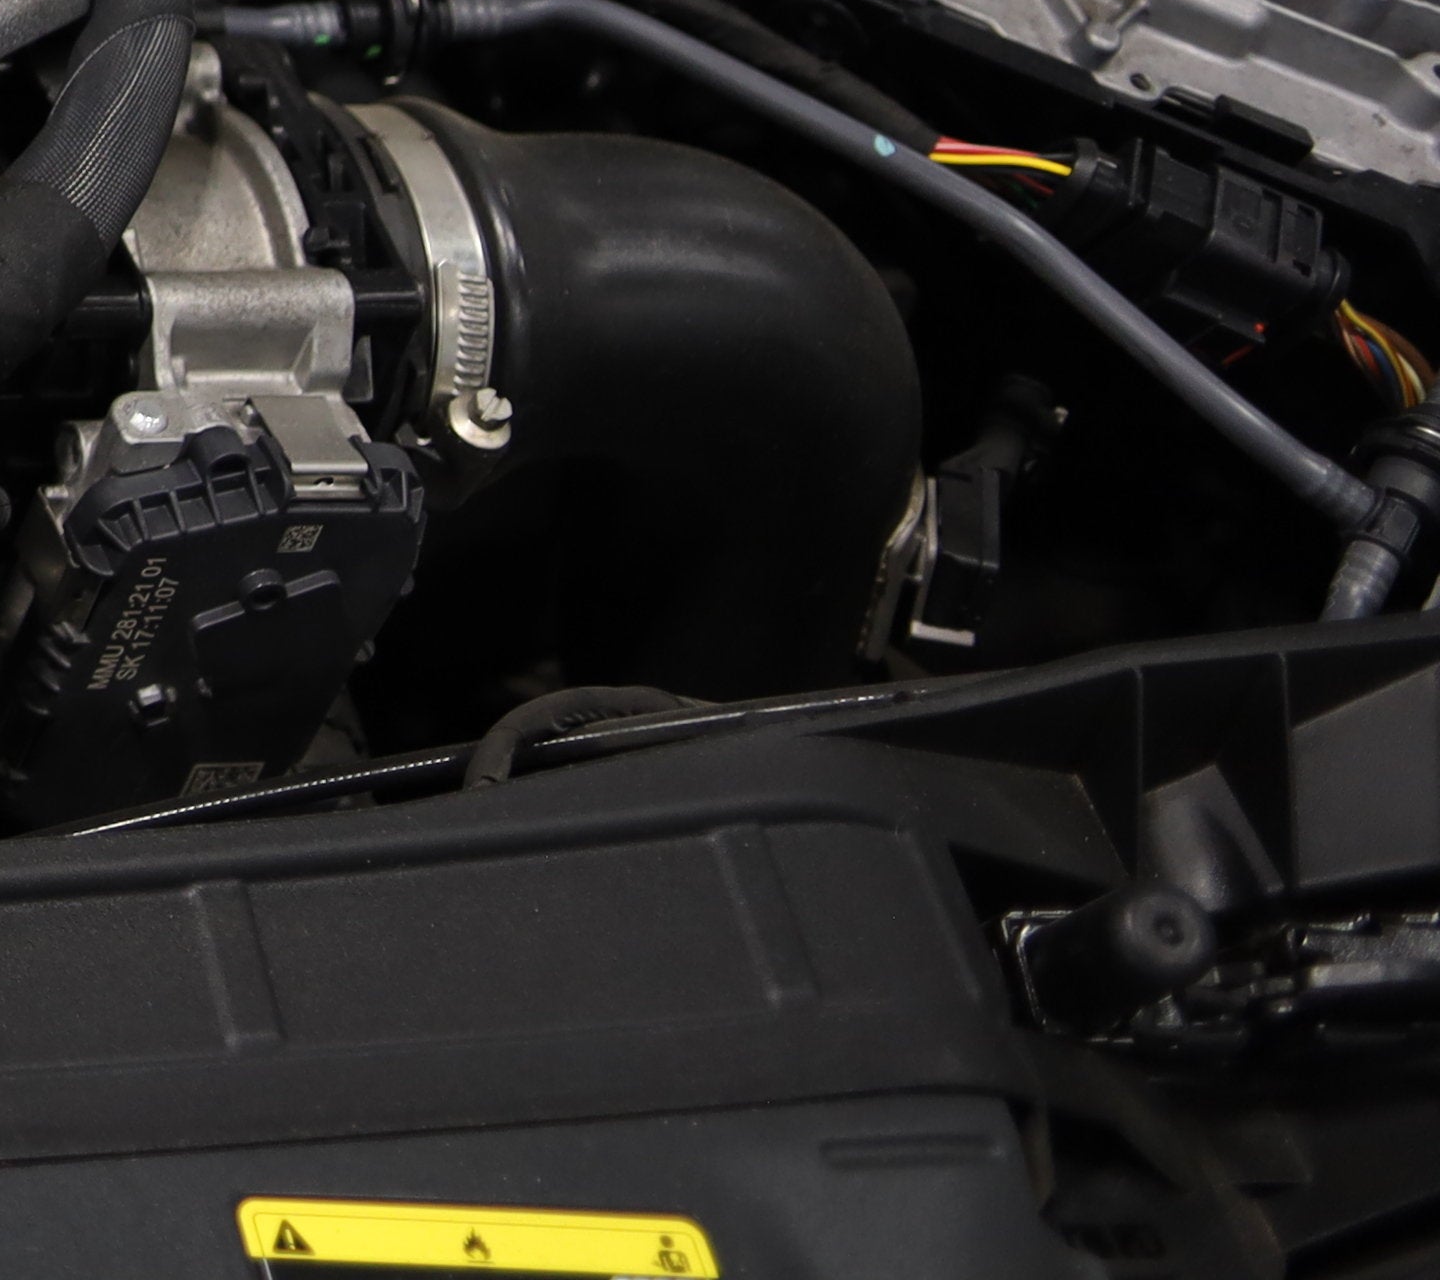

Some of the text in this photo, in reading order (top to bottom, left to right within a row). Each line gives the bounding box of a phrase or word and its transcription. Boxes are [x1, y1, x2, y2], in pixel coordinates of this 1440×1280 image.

[87, 645, 124, 689] MMU
[141, 558, 168, 578] 01
[116, 654, 146, 681] SK
